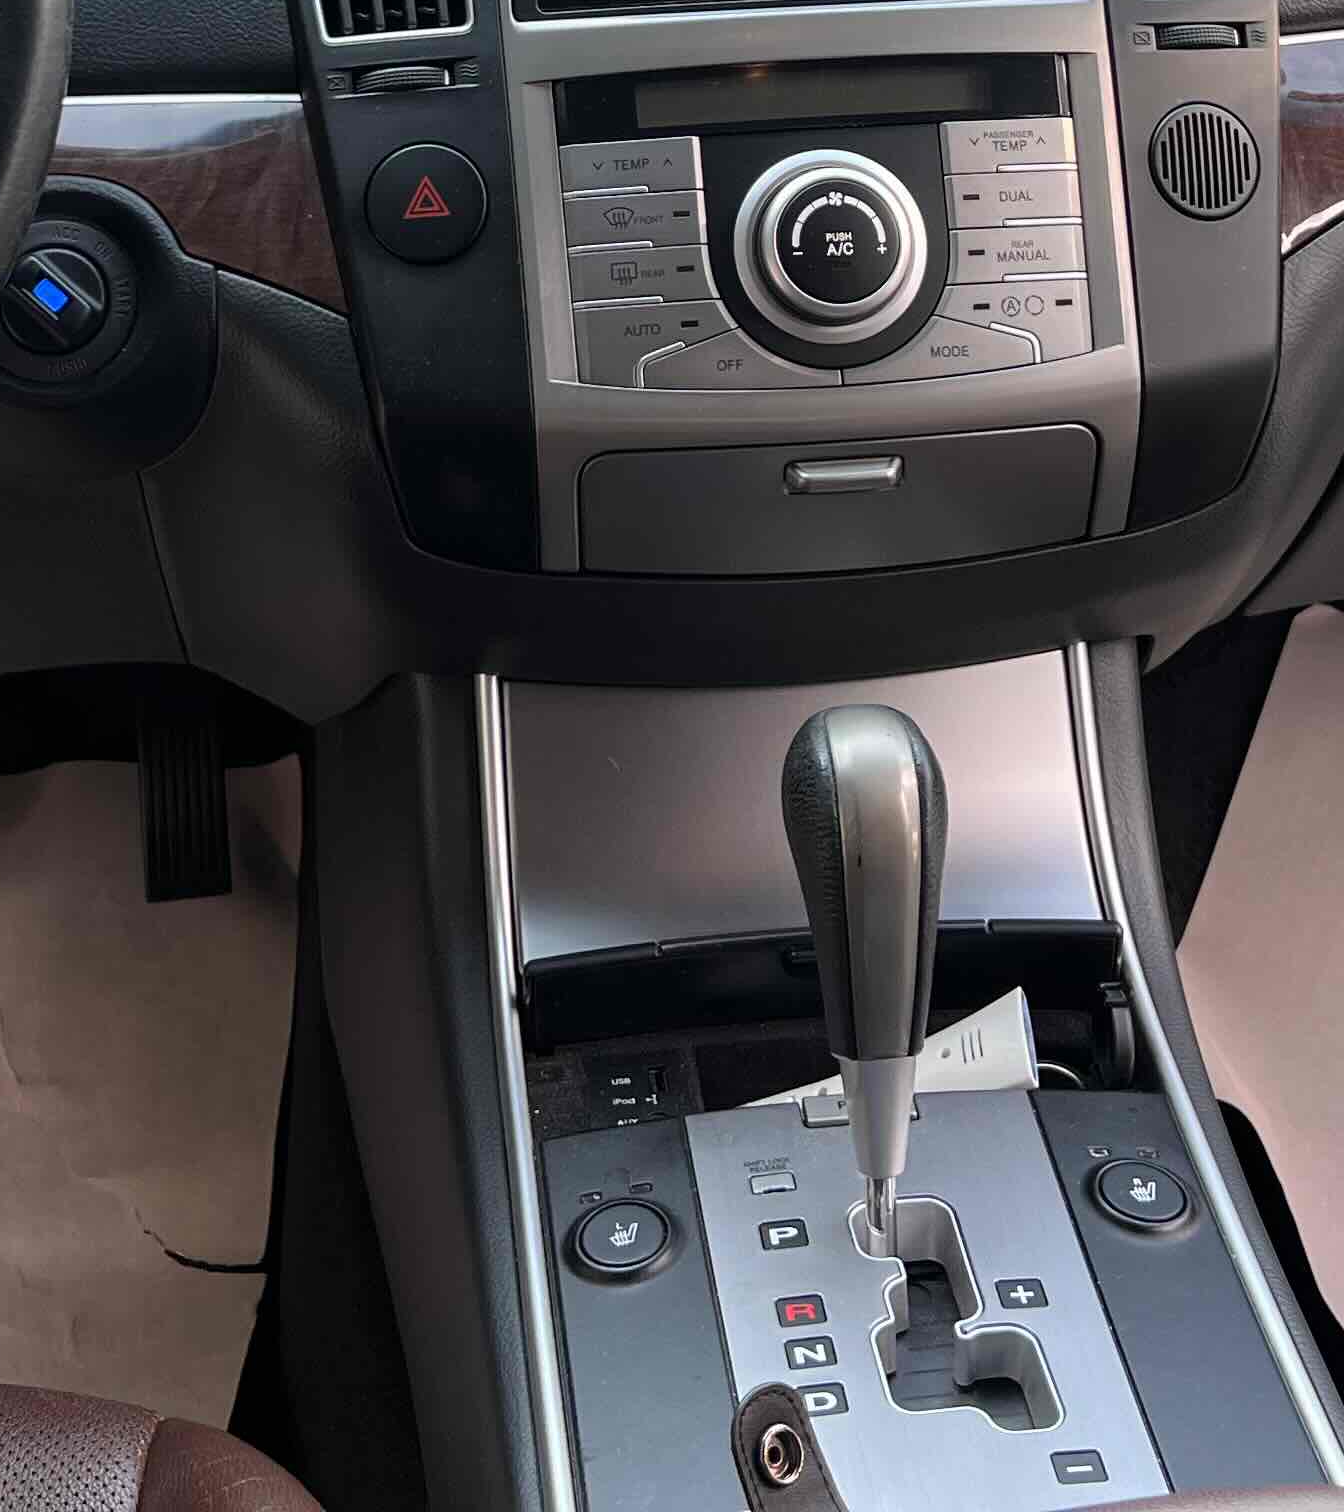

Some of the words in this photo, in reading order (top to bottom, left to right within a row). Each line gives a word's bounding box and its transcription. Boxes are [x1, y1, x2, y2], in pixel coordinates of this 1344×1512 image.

[983, 129, 1034, 139] PASSENGER
[992, 139, 1028, 153] TEMP
[614, 158, 649, 172] TEMP
[999, 190, 1033, 203] DUAL
[633, 214, 664, 226] FRONT
[825, 231, 853, 243] PUSH
[1011, 239, 1034, 249] REAR
[827, 242, 854, 257] A/C
[997, 249, 1050, 264] MANUAL
[640, 268, 665, 280] REAR
[624, 324, 661, 338] AUTO
[930, 345, 970, 359] MODE
[717, 358, 744, 373] OFF
[611, 1077, 632, 1086] USB
[612, 1096, 636, 1106] iPod
[768, 1225, 799, 1246] P
[785, 1303, 816, 1321] R
[793, 1343, 827, 1365] N
[804, 1391, 837, 1412] D
